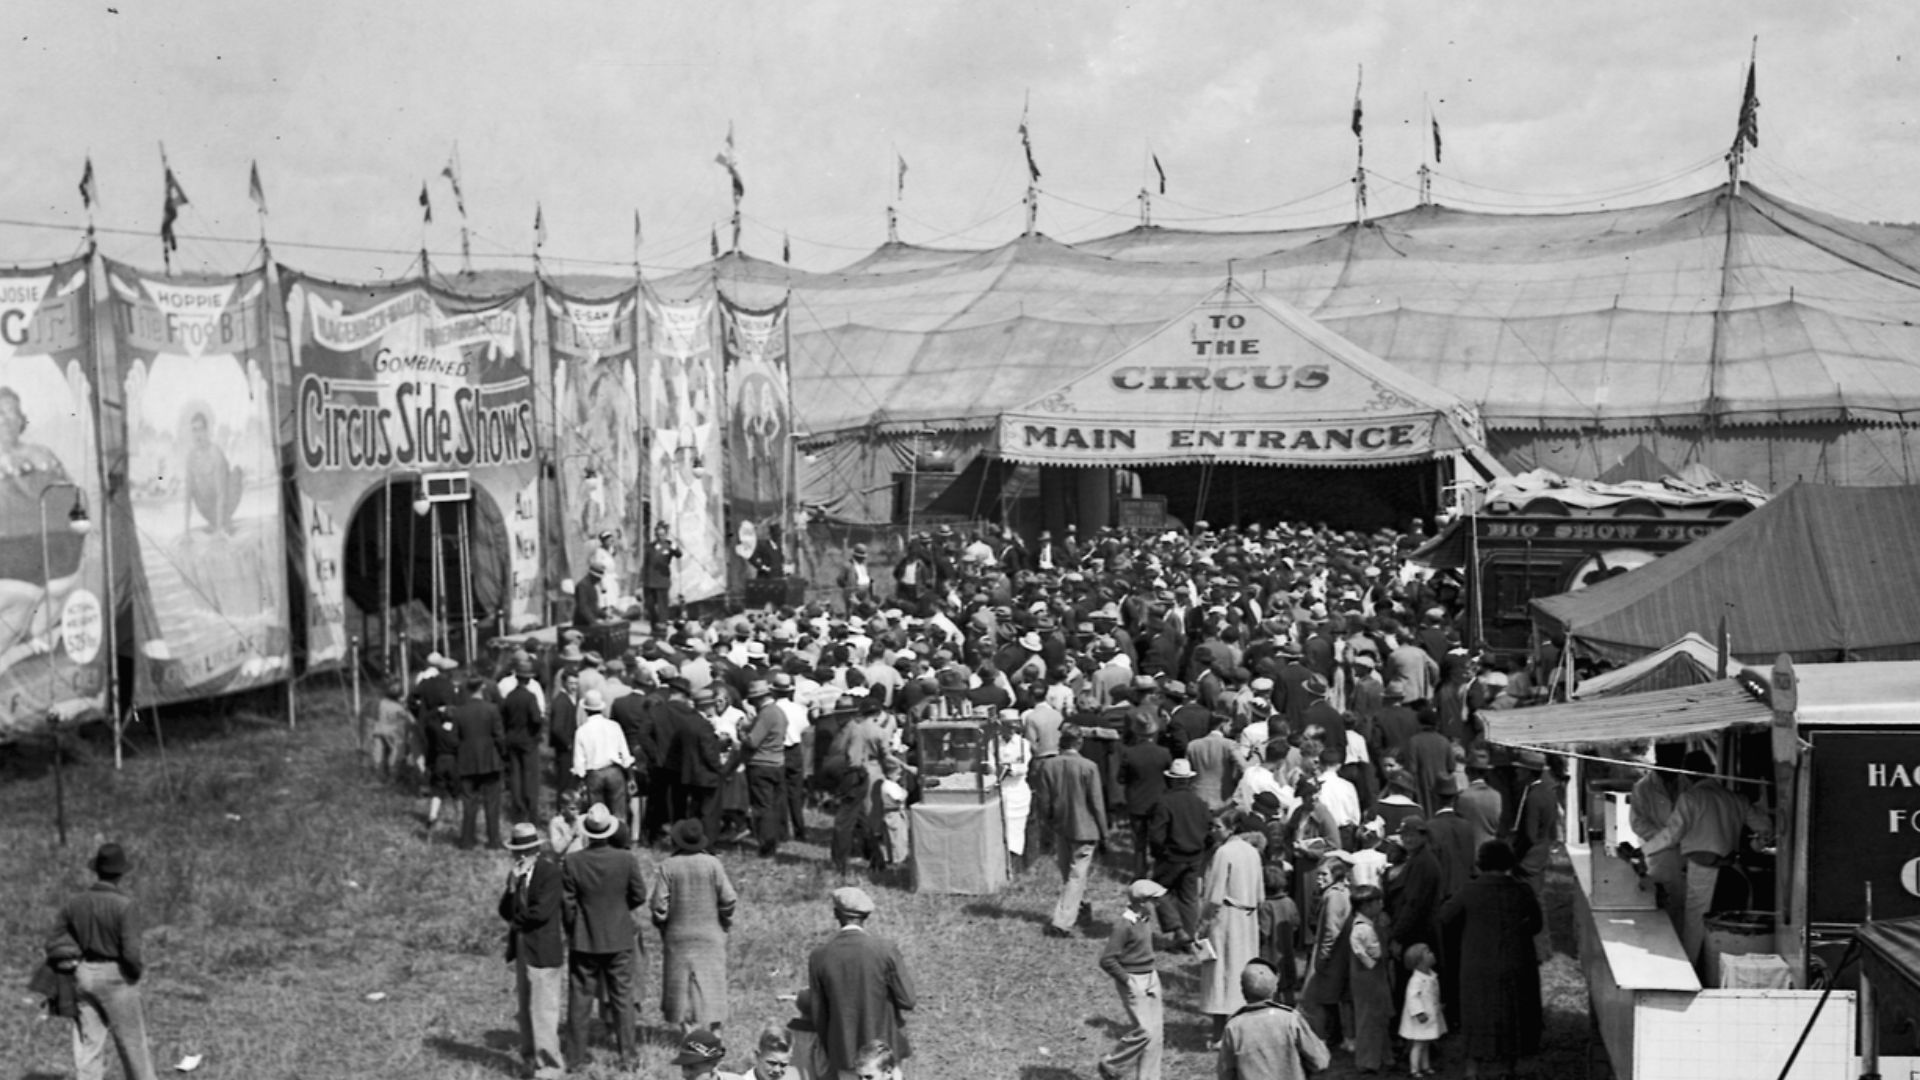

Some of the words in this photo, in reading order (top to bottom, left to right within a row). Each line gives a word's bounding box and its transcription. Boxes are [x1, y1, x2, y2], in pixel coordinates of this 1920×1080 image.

[158, 290, 222, 309] HOPPIE
[165, 312, 216, 347] Frog
[1208, 314, 1246, 330] TO
[1191, 339, 1260, 356] THE
[1110, 364, 1331, 391] CIRCUS
[301, 375, 393, 467] Circus
[395, 381, 452, 465] Side
[455, 386, 534, 465] Shows
[1023, 425, 1137, 449] MAIN
[1170, 424, 1416, 450] ENTRANCE
[1553, 523, 1642, 540] SHOW
